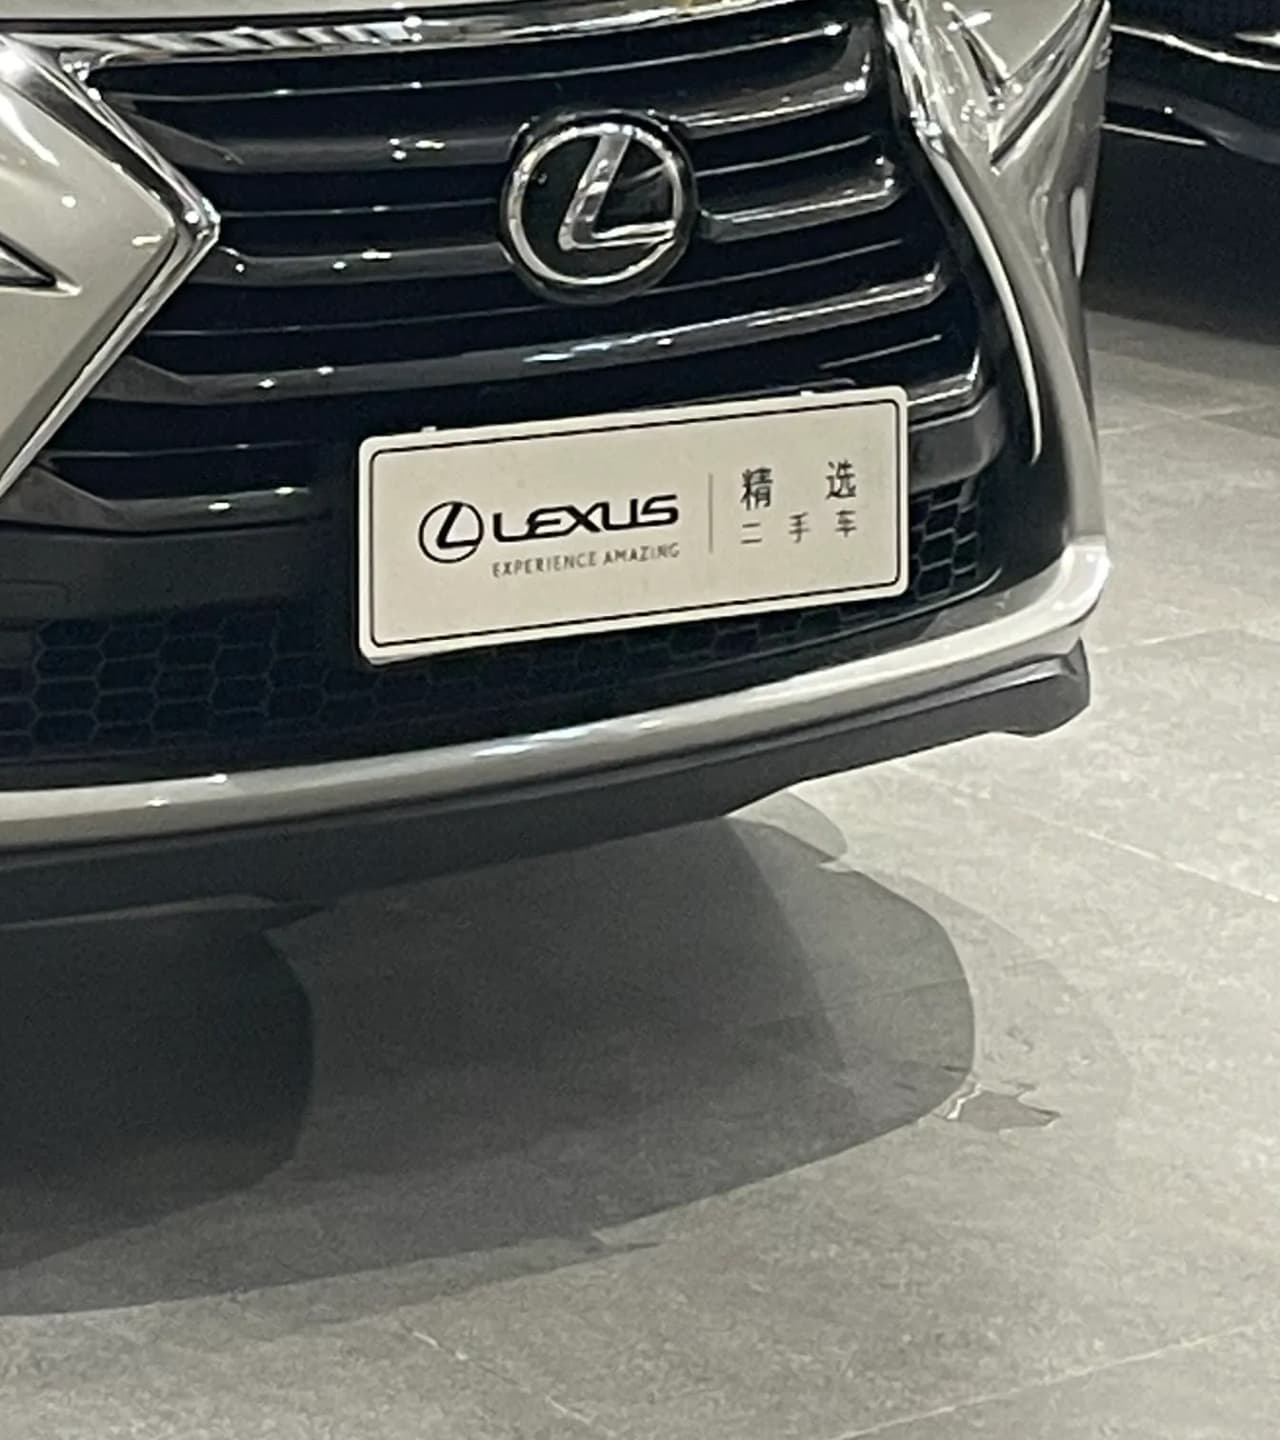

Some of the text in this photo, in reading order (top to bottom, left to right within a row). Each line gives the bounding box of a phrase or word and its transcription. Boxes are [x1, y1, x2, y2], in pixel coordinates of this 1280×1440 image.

[739, 458, 858, 512] 精选
[492, 493, 680, 542] LEXUS
[739, 509, 858, 545] 二手车
[492, 542, 681, 579] EXPERIENCE AMAZING
